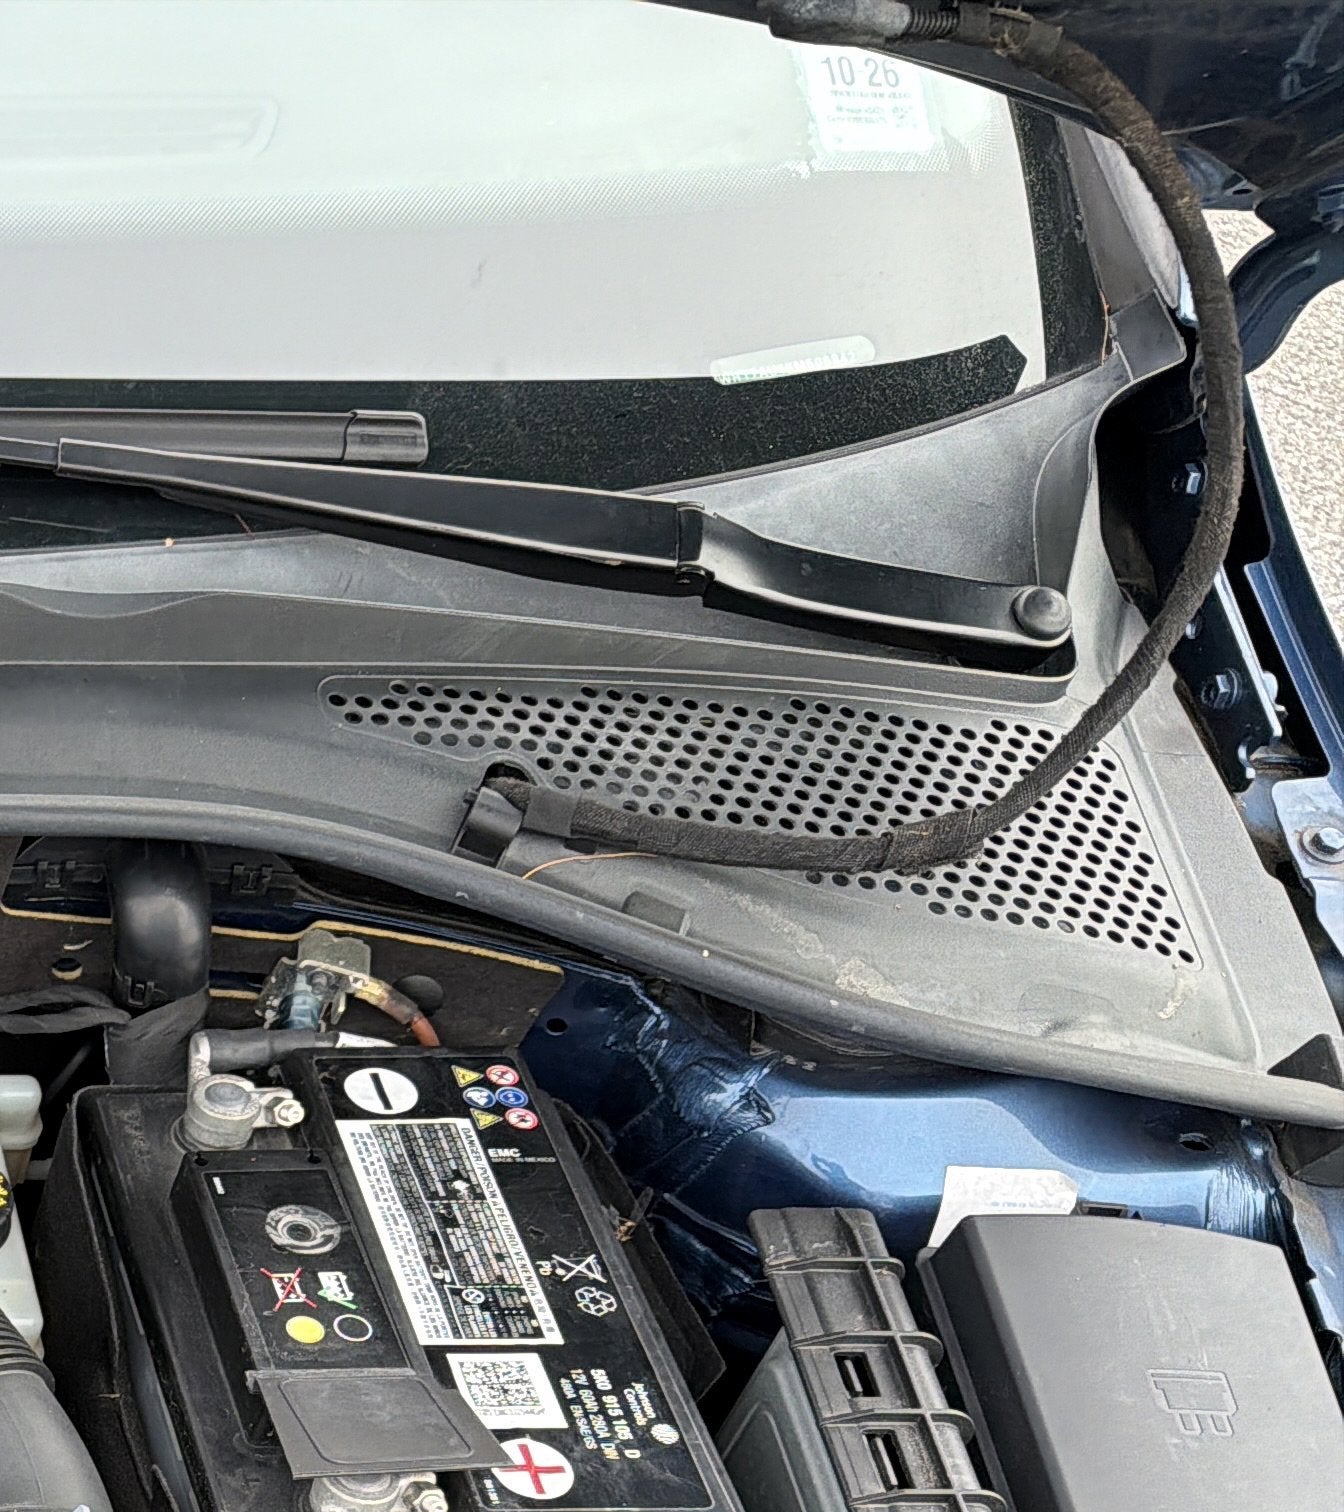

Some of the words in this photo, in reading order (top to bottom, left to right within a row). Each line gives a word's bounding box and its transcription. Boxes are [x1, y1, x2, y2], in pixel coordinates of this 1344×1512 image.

[488, 1147, 520, 1158] EMC
[569, 1368, 588, 1387] 12V
[623, 1388, 647, 1426] Controls
[631, 1382, 656, 1419] Johnson
[601, 1394, 624, 1418] 915
[624, 1447, 641, 1460] D
